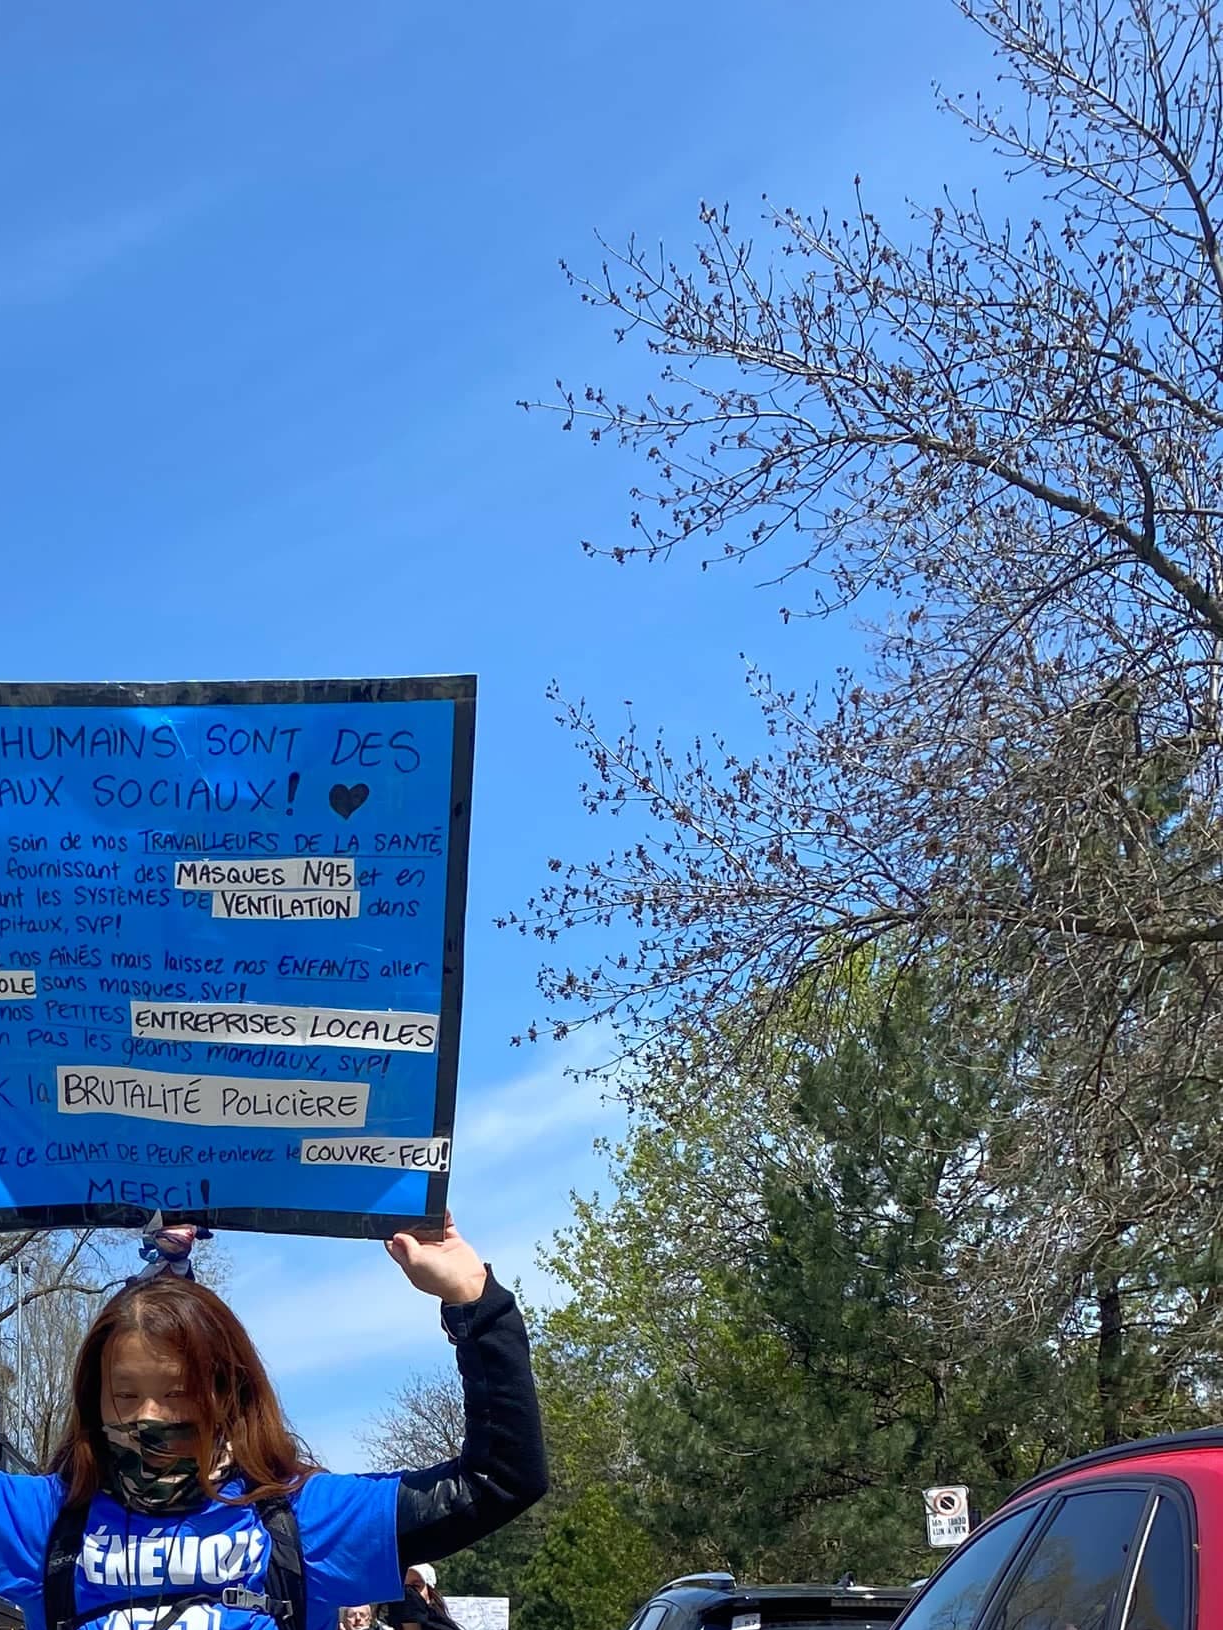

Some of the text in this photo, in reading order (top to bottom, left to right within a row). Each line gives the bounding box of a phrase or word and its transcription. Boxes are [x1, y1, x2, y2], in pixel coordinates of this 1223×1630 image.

[1, 724, 177, 760] HUMAINS
[207, 724, 302, 762] SONT
[331, 728, 420, 773] DES
[9, 832, 47, 852] soin
[60, 831, 81, 851] de
[92, 834, 128, 852] nos
[138, 829, 280, 853] TRAVAILLEURS
[295, 832, 323, 854] DE
[334, 833, 360, 854] LA
[5, 857, 121, 881] fournissant
[134, 864, 167, 884] des
[177, 862, 285, 886] MASQUES
[303, 861, 353, 887] N95
[357, 869, 382, 887] et
[396, 869, 426, 887] en
[37, 890, 62, 907] les
[74, 886, 170, 908] SYSTÈMES
[182, 891, 210, 910] DE
[221, 890, 352, 919] VENTILATION
[367, 899, 419, 917] dans
[77, 914, 122, 938] SVP!
[9, 950, 42, 967] nos
[111, 950, 152, 970] mais
[164, 951, 224, 974] laissez
[234, 959, 268, 975] nos
[277, 954, 371, 979] ENFANTS
[379, 959, 429, 978] aller
[42, 976, 87, 991] sans
[201, 982, 248, 1001] SVP!
[0, 1005, 35, 1022] nos
[45, 1001, 125, 1024] PETITES
[135, 1010, 297, 1037] ENTREPRISES
[309, 1015, 436, 1047] LOCALES
[27, 1028, 70, 1048] pas
[84, 1030, 112, 1050] les
[121, 1030, 193, 1064] géants
[337, 1053, 392, 1081] SVP!
[27, 1074, 51, 1105] la
[64, 1073, 203, 1115] BRUTALITÉ
[222, 1087, 358, 1118] POLICIÈRE
[16, 1147, 39, 1168] ce
[45, 1142, 109, 1162] CLIMAT
[118, 1144, 139, 1162] DE
[146, 1143, 194, 1165] PEUR
[87, 1179, 210, 1209] MERCI!
